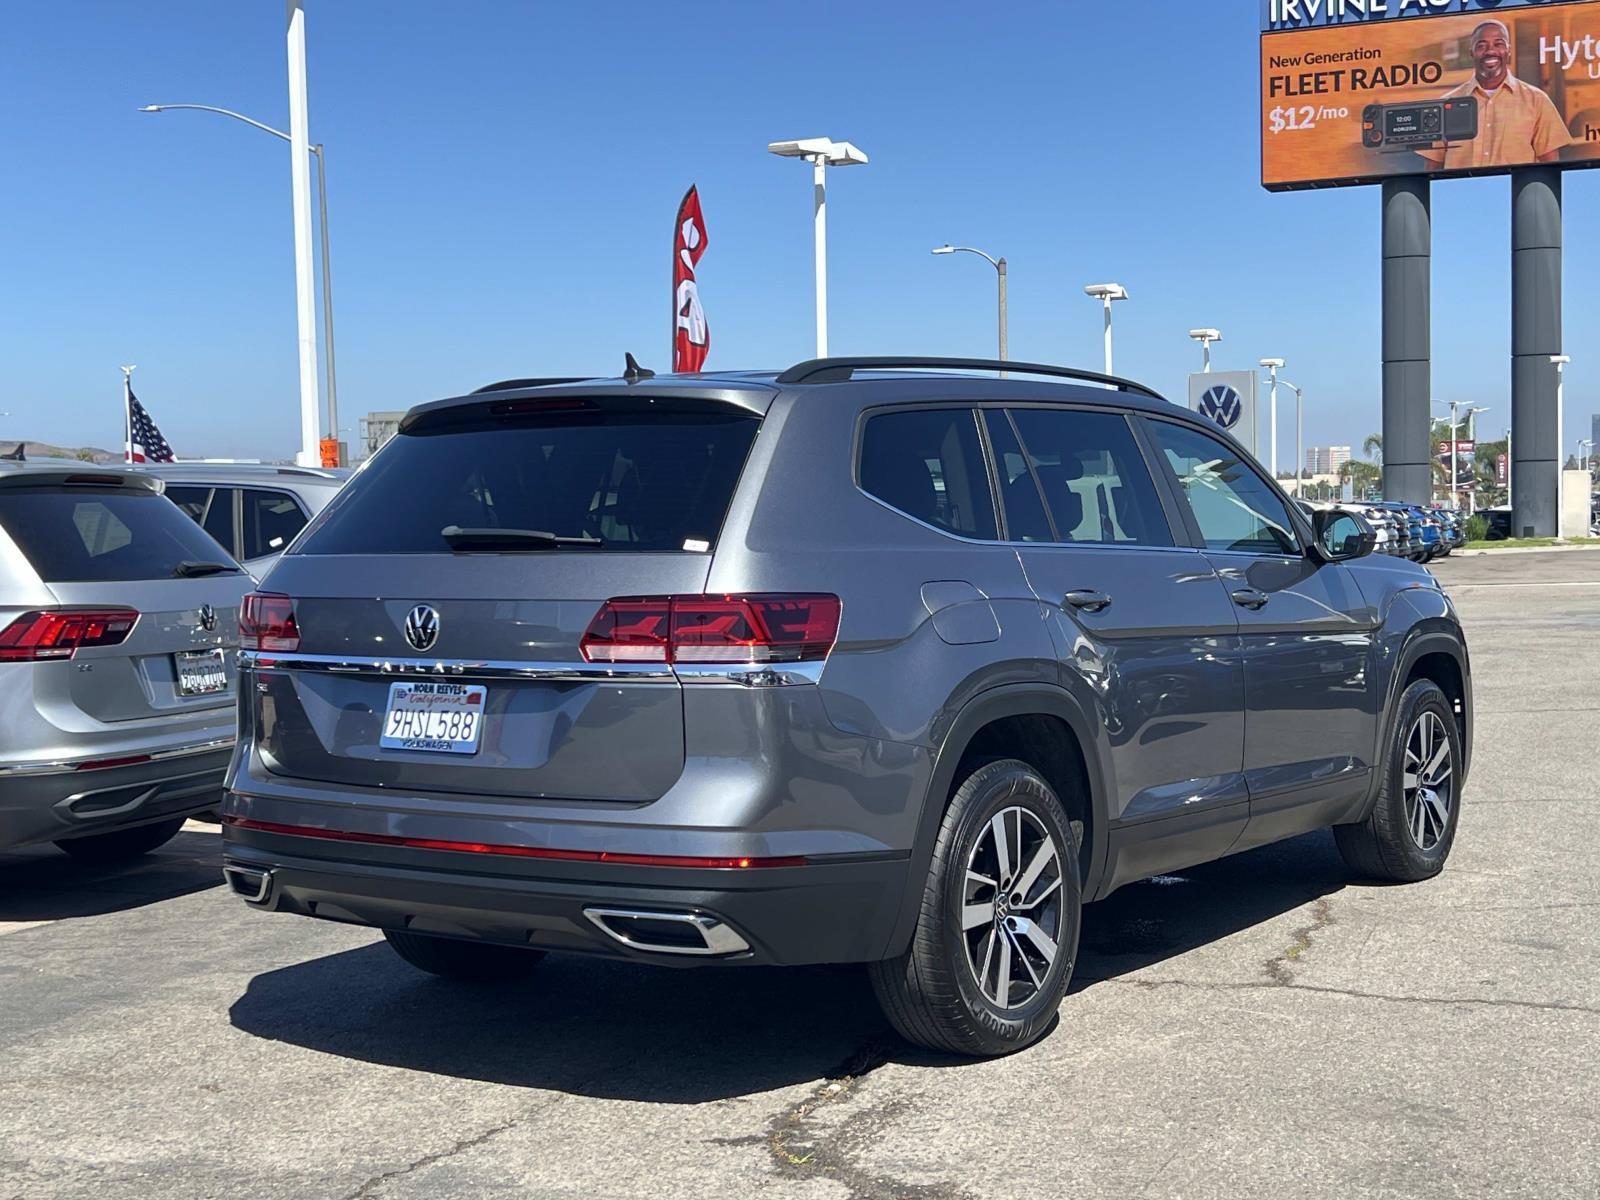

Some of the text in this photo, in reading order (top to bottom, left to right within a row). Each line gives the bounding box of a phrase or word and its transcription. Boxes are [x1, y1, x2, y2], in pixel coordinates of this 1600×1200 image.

[1269, 47, 1382, 69] New Generation
[1539, 34, 1600, 70] Hyt
[1269, 62, 1442, 98] FLEET RADIO
[414, 683, 436, 694] NORM
[437, 684, 462, 695] REEVES
[409, 694, 463, 708] California
[391, 709, 475, 740] 9HSL588
[402, 739, 454, 750] VOLKSWAGEN
